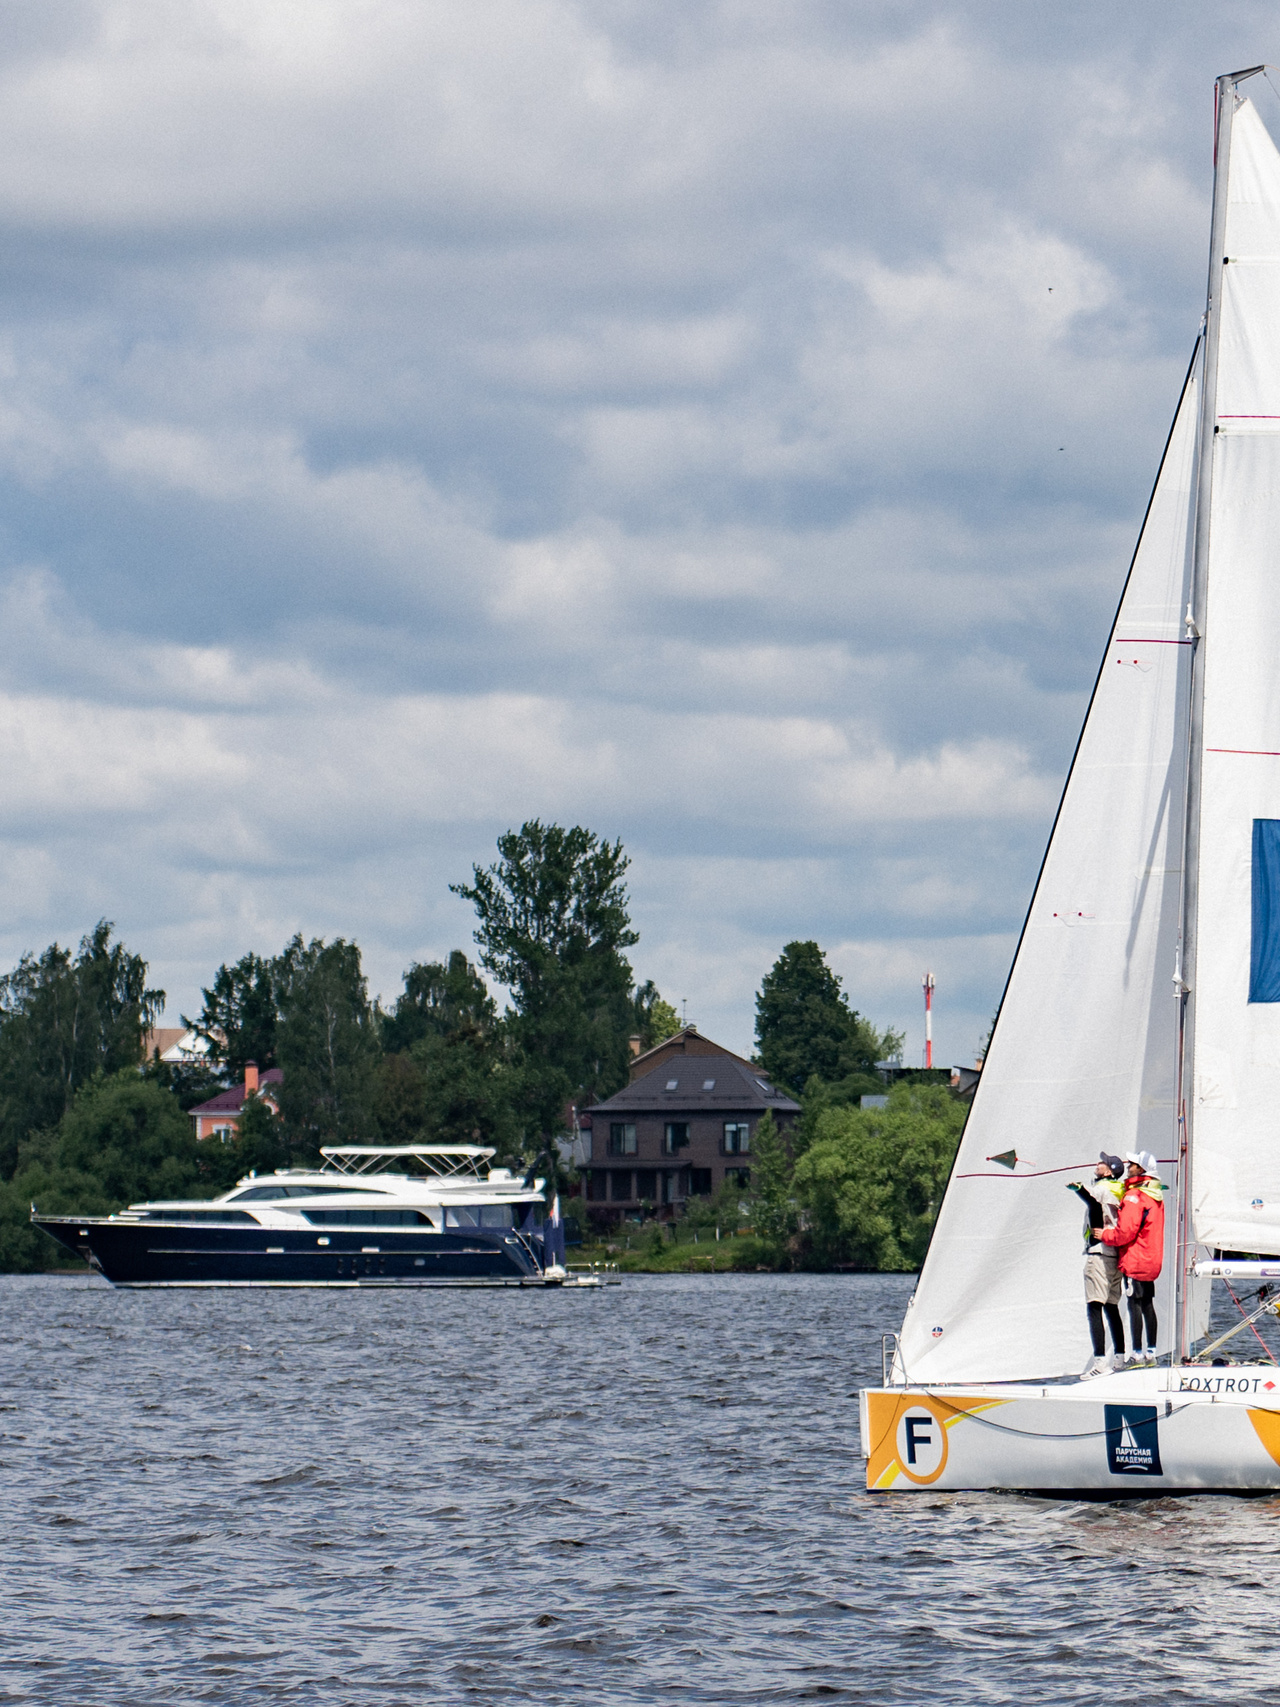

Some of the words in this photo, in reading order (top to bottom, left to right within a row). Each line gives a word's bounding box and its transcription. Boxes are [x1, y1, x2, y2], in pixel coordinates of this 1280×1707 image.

[1180, 1377, 1262, 1393] FOXTROT
[905, 1416, 933, 1464] F
[1115, 1447, 1152, 1457] ПАРУСНАЯ
[1115, 1455, 1153, 1465] АКАДЕМИЯ
